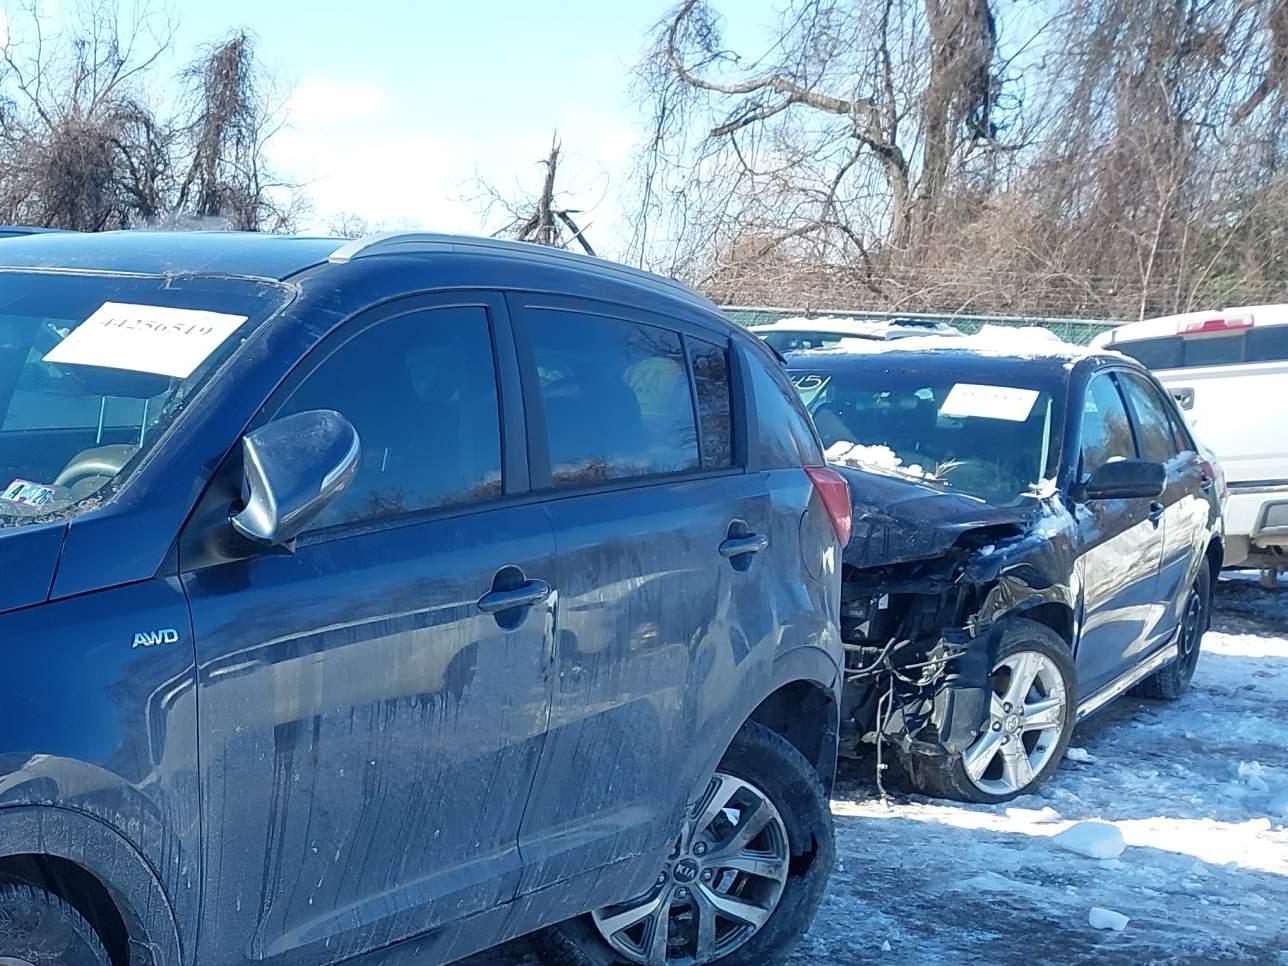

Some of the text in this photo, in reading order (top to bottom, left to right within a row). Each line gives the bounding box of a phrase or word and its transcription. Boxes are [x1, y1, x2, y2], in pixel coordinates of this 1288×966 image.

[99, 317, 214, 336] 44256519
[131, 628, 179, 649] AWD
[675, 863, 696, 879] KIA
